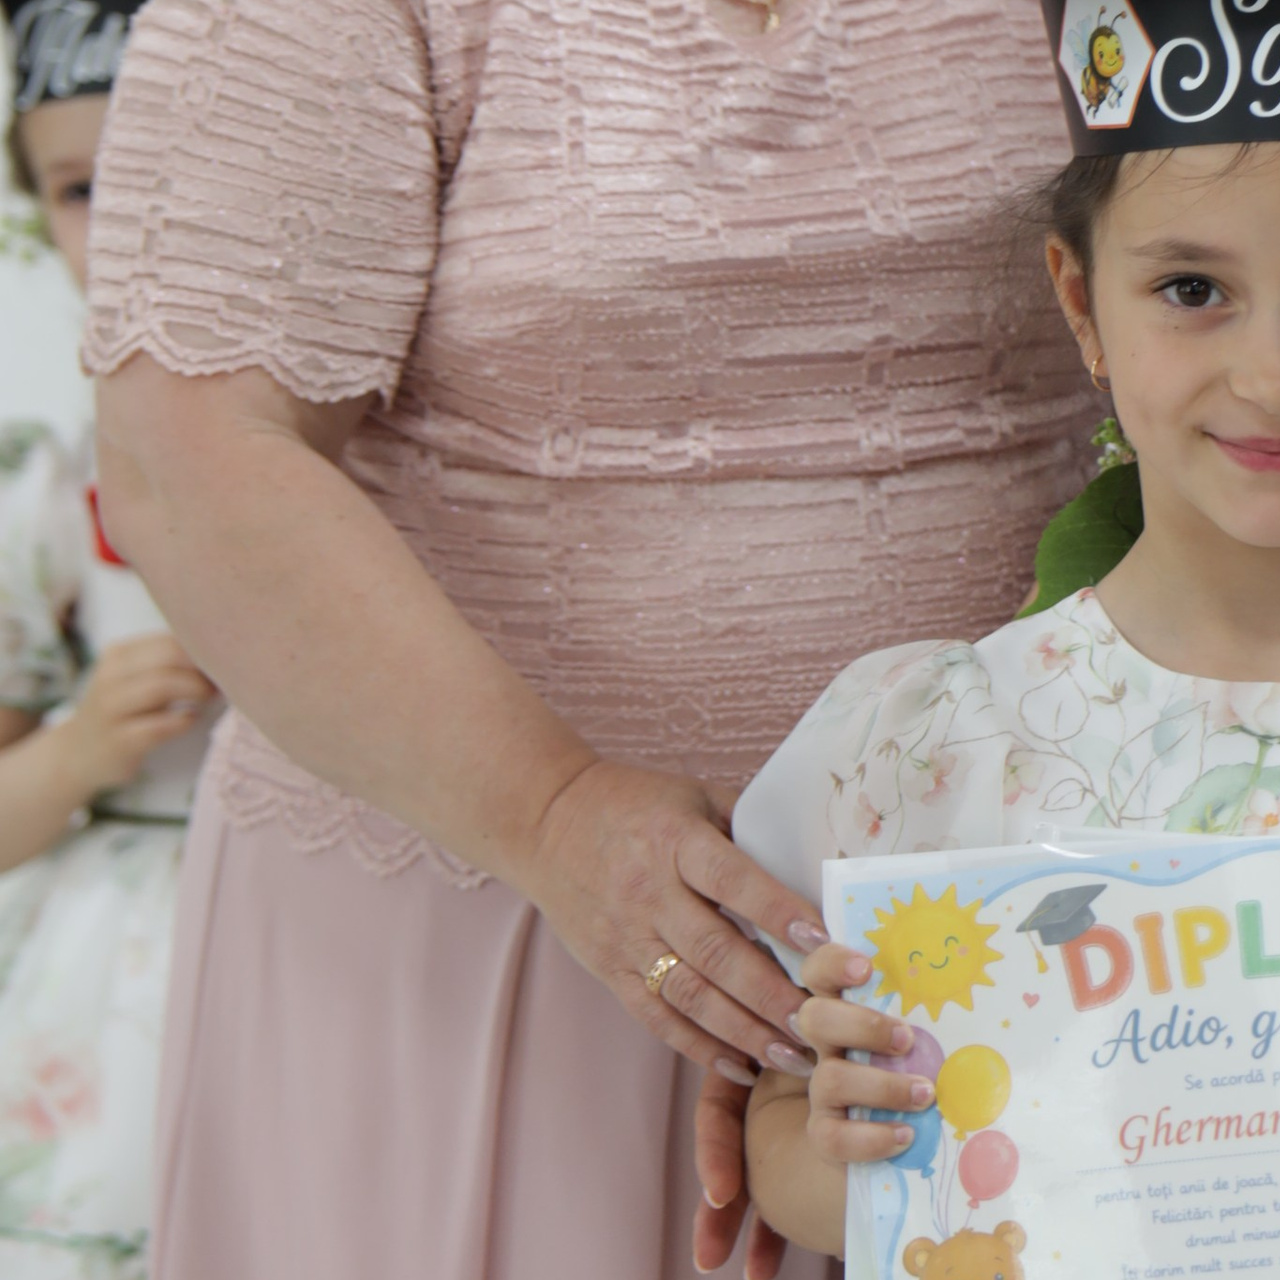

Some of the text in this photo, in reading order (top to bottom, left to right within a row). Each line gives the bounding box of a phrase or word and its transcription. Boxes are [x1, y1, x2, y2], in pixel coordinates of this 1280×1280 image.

[1092, 1004, 1234, 1068] Adio,
[1184, 1074, 1203, 1090] Se
[1210, 1068, 1265, 1088] acordă
[1095, 1186, 1141, 1207] pentru
[1147, 1183, 1173, 1200] toți
[1180, 1179, 1205, 1194] anii
[1212, 1176, 1229, 1191] de
[1234, 1172, 1278, 1193] joacă,
[1152, 1206, 1214, 1224] Felicitări
[1219, 1201, 1266, 1221] pentru
[1186, 1230, 1236, 1248] drumul
[1144, 1263, 1185, 1280] dorim
[1191, 1258, 1222, 1275] mult
[1229, 1255, 1274, 1270] succes
